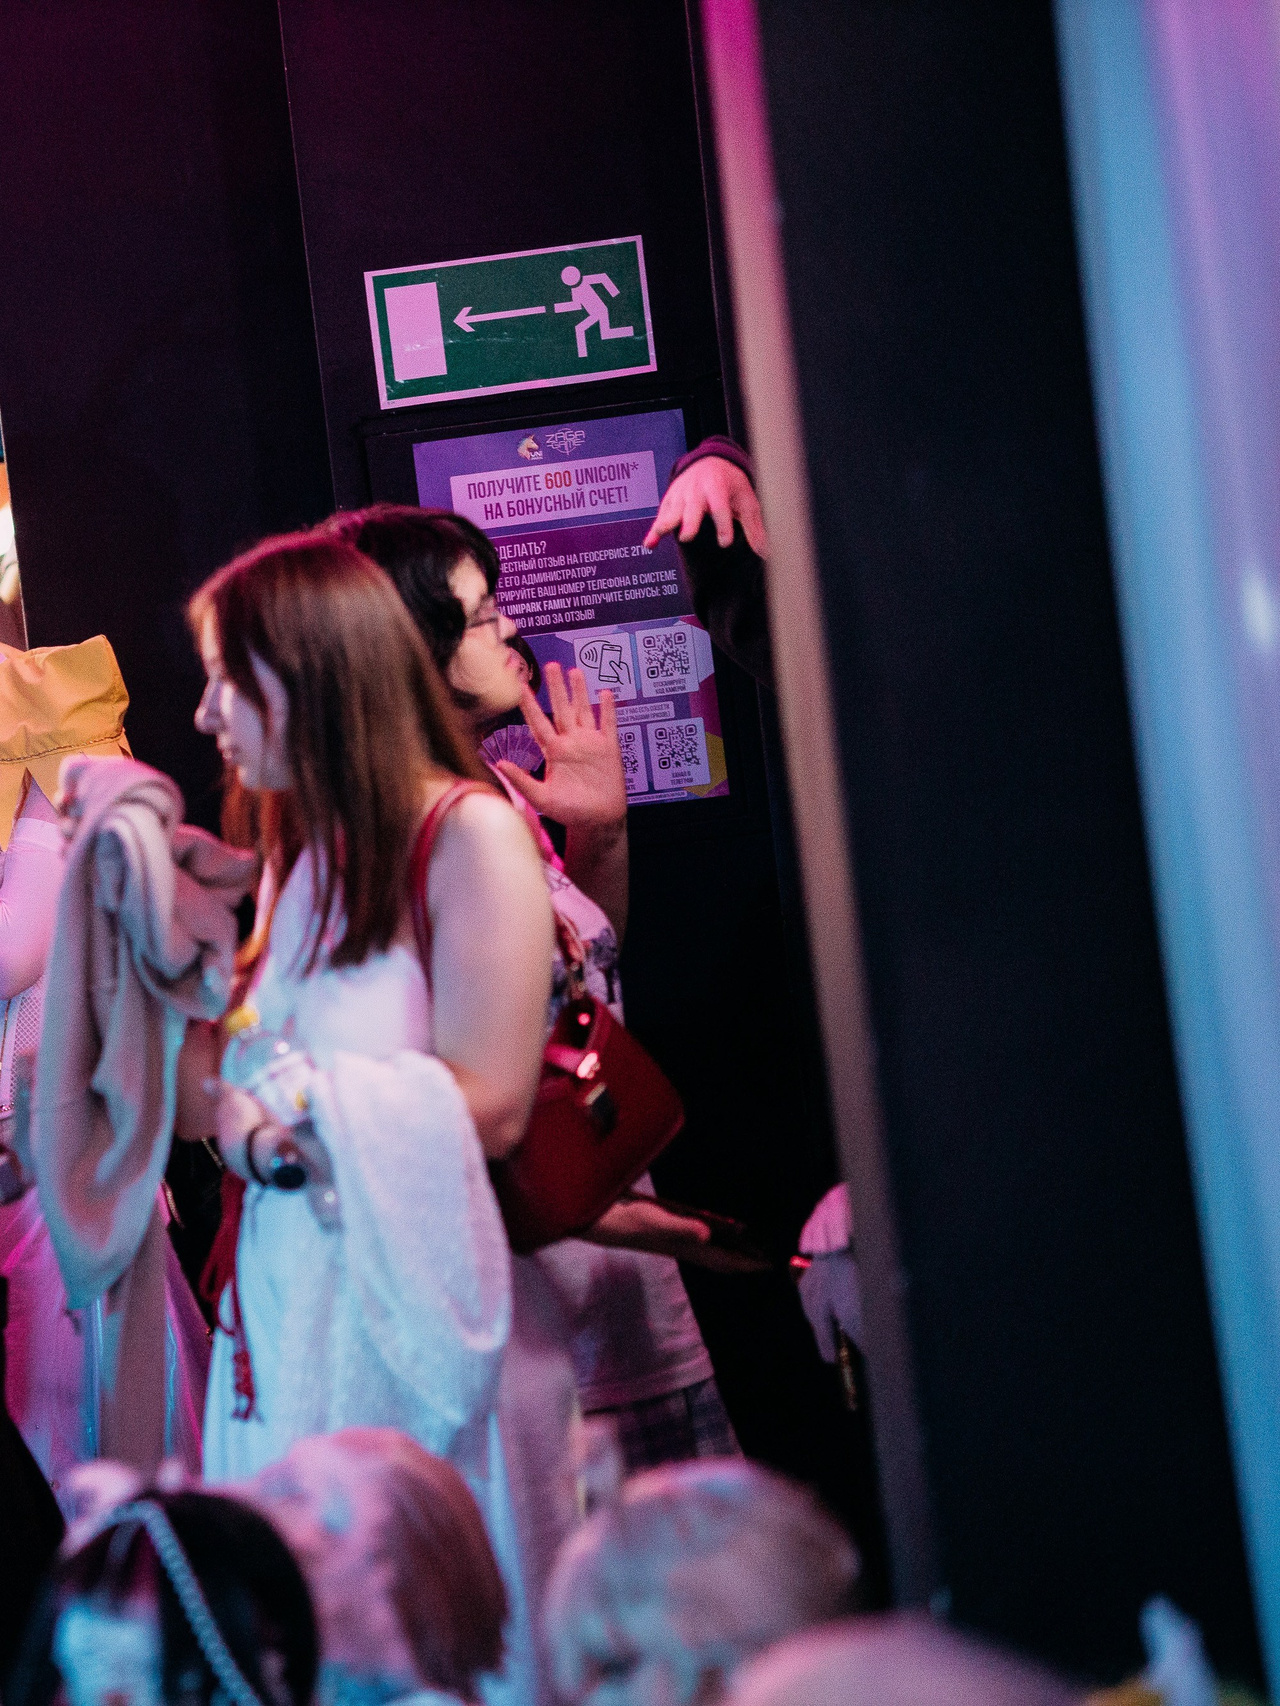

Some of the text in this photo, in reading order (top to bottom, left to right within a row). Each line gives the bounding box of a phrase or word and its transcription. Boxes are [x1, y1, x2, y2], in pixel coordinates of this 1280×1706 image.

[467, 475, 541, 500] ПОЛУЧИТЕ
[544, 470, 572, 490] 600
[484, 486, 628, 520] НА БОНУСНЫЙ СЧЕТ!
[537, 555, 566, 569] ОТЗЫВ
[566, 553, 579, 566] НА
[579, 546, 630, 564] ГЕОСЕРВИСЕ
[496, 569, 677, 603] ТРИРУЙТЕ ВАШ НОМЕР ТЕЛЕФОНА В СИСТЕМЕ
[505, 575, 520, 588] ЕГО
[521, 566, 597, 586] АДМИНИСТРАТОРУ
[507, 601, 542, 616] UNIPARK
[543, 597, 572, 611] FAMILY
[573, 596, 580, 607] И
[580, 590, 624, 607] ПОЛУЧИТЕ
[662, 583, 679, 596] 300
[527, 616, 535, 628] И
[535, 614, 552, 627] 300
[551, 612, 564, 624] ЗА
[564, 608, 596, 623] ОТЗЫВ!
